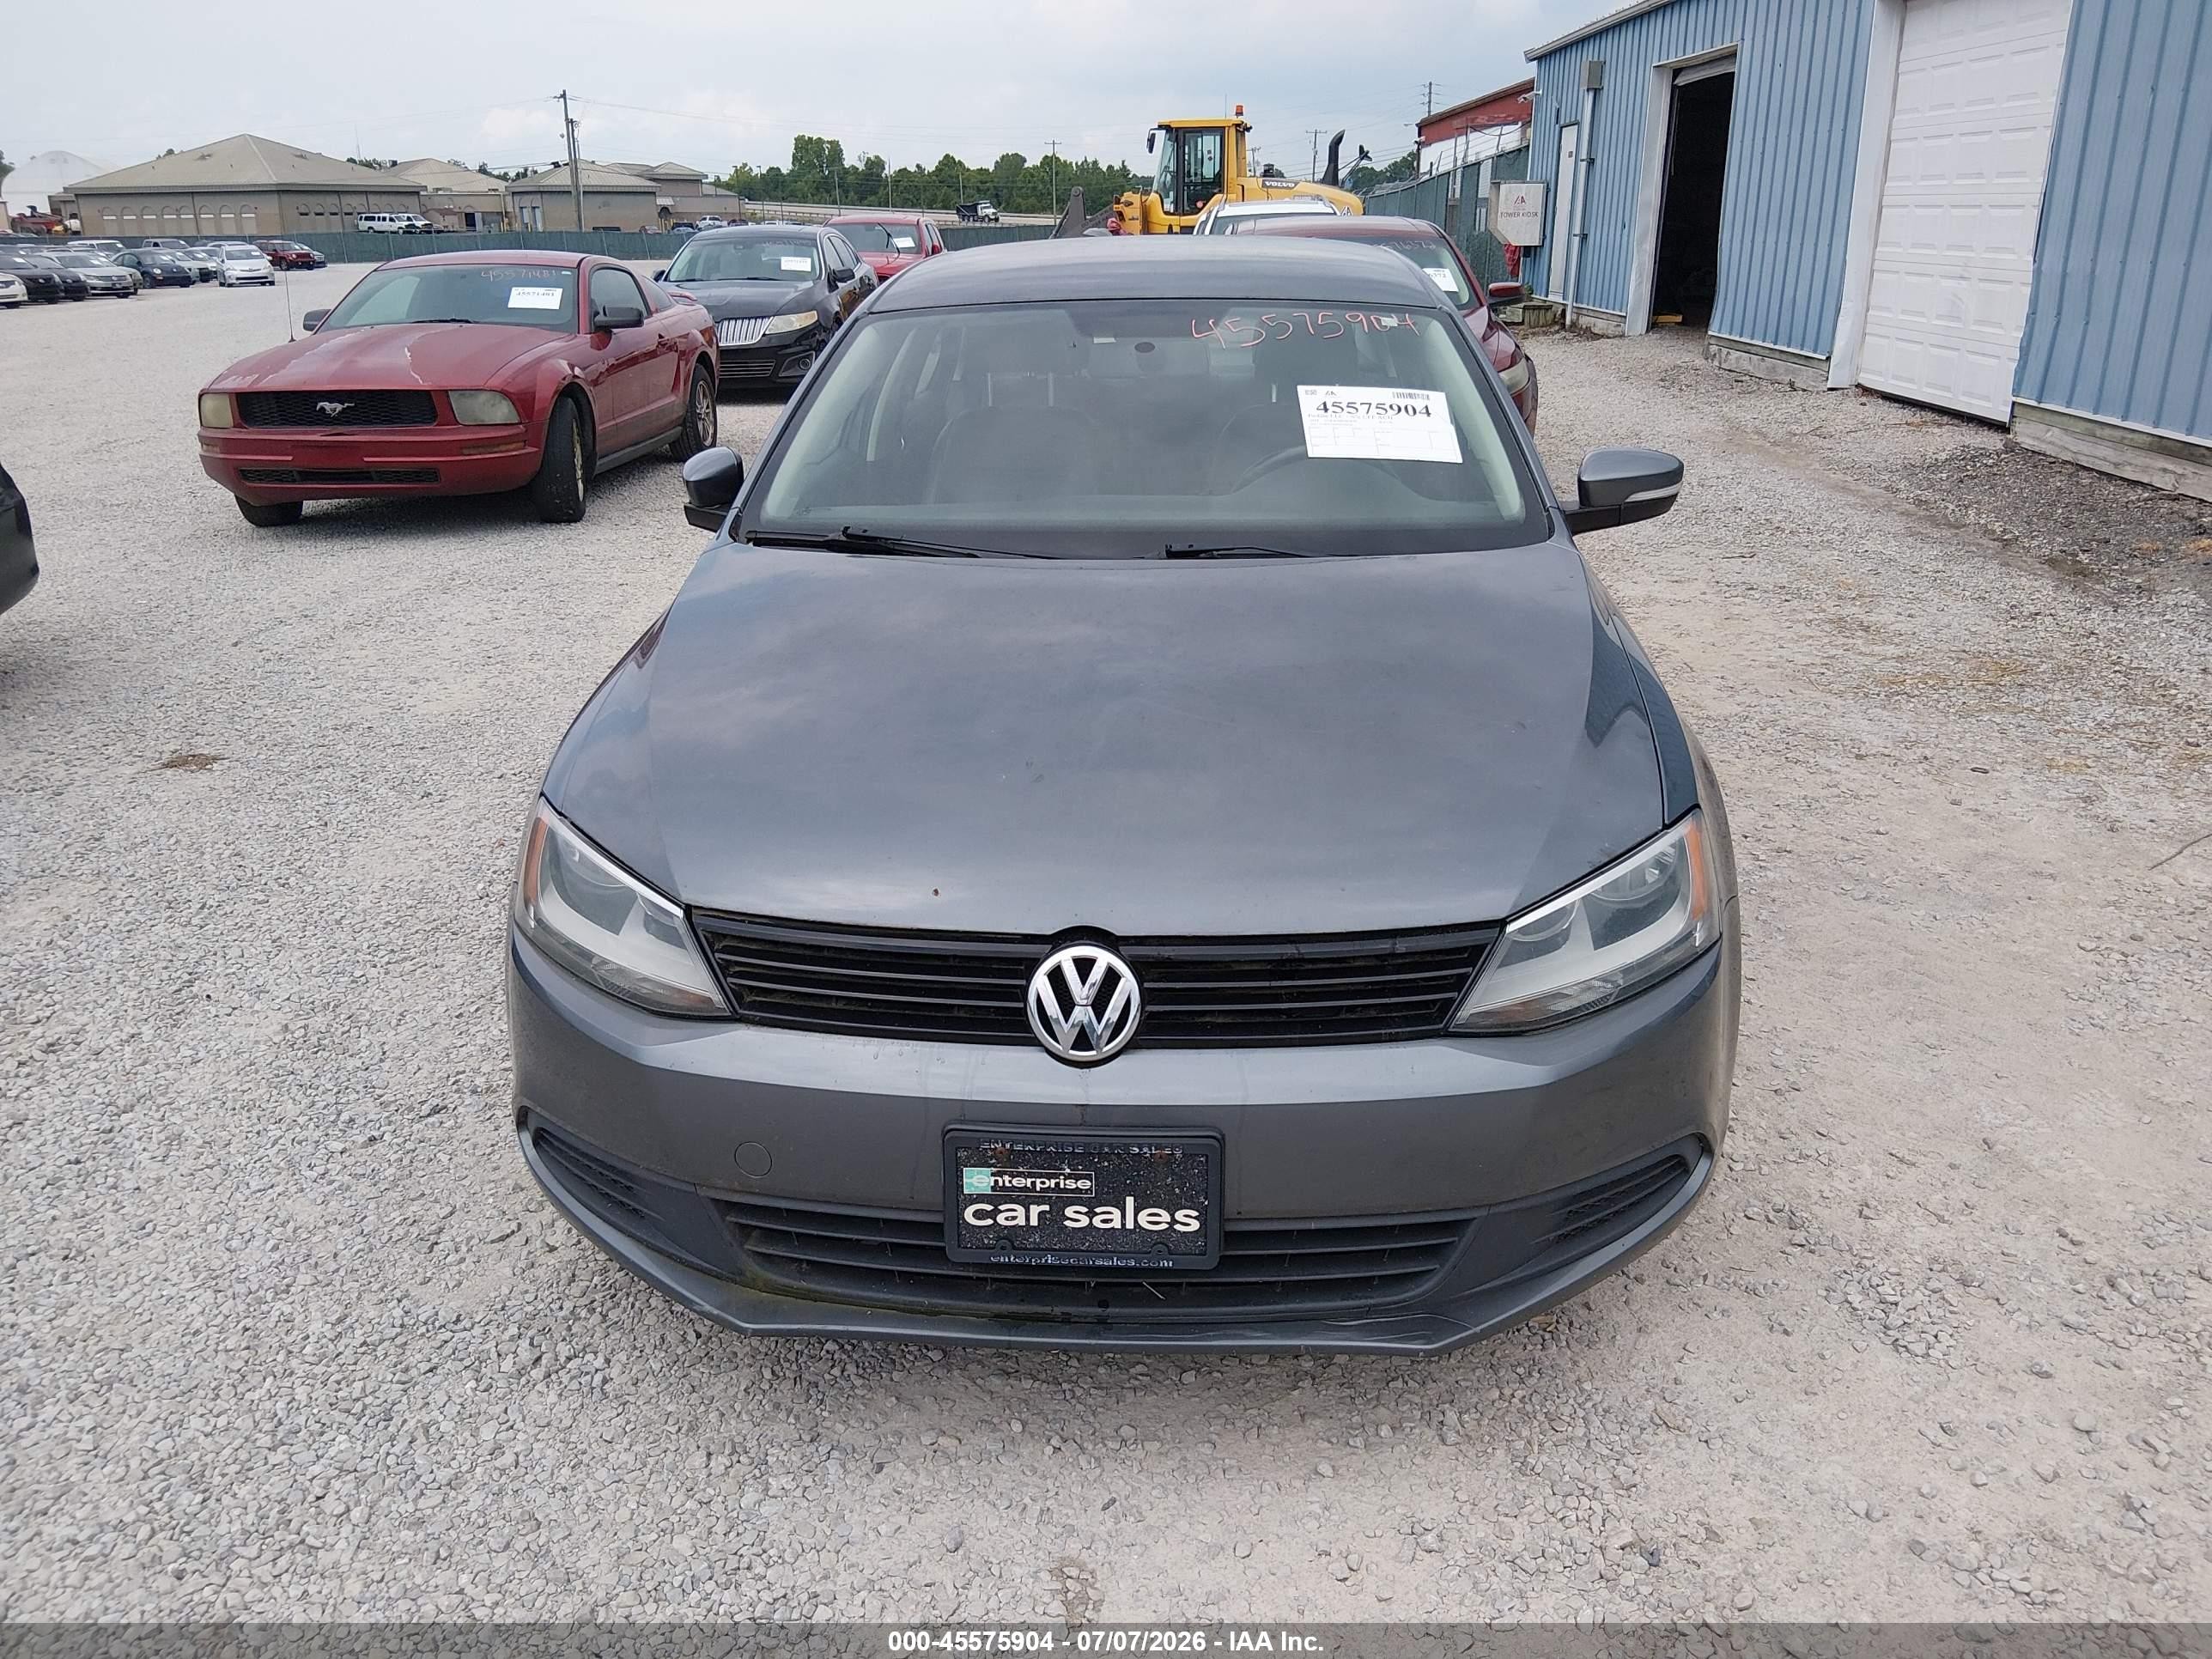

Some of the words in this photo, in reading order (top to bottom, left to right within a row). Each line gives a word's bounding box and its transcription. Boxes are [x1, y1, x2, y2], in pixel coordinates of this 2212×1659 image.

[1192, 311, 1419, 349] 45575904
[1316, 400, 1432, 417] 45575904
[970, 1174, 1092, 1192] enterprise
[963, 1202, 1050, 1227] car
[1063, 1196, 1201, 1233] sales
[990, 1254, 1174, 1268] enterprisecarsales.com
